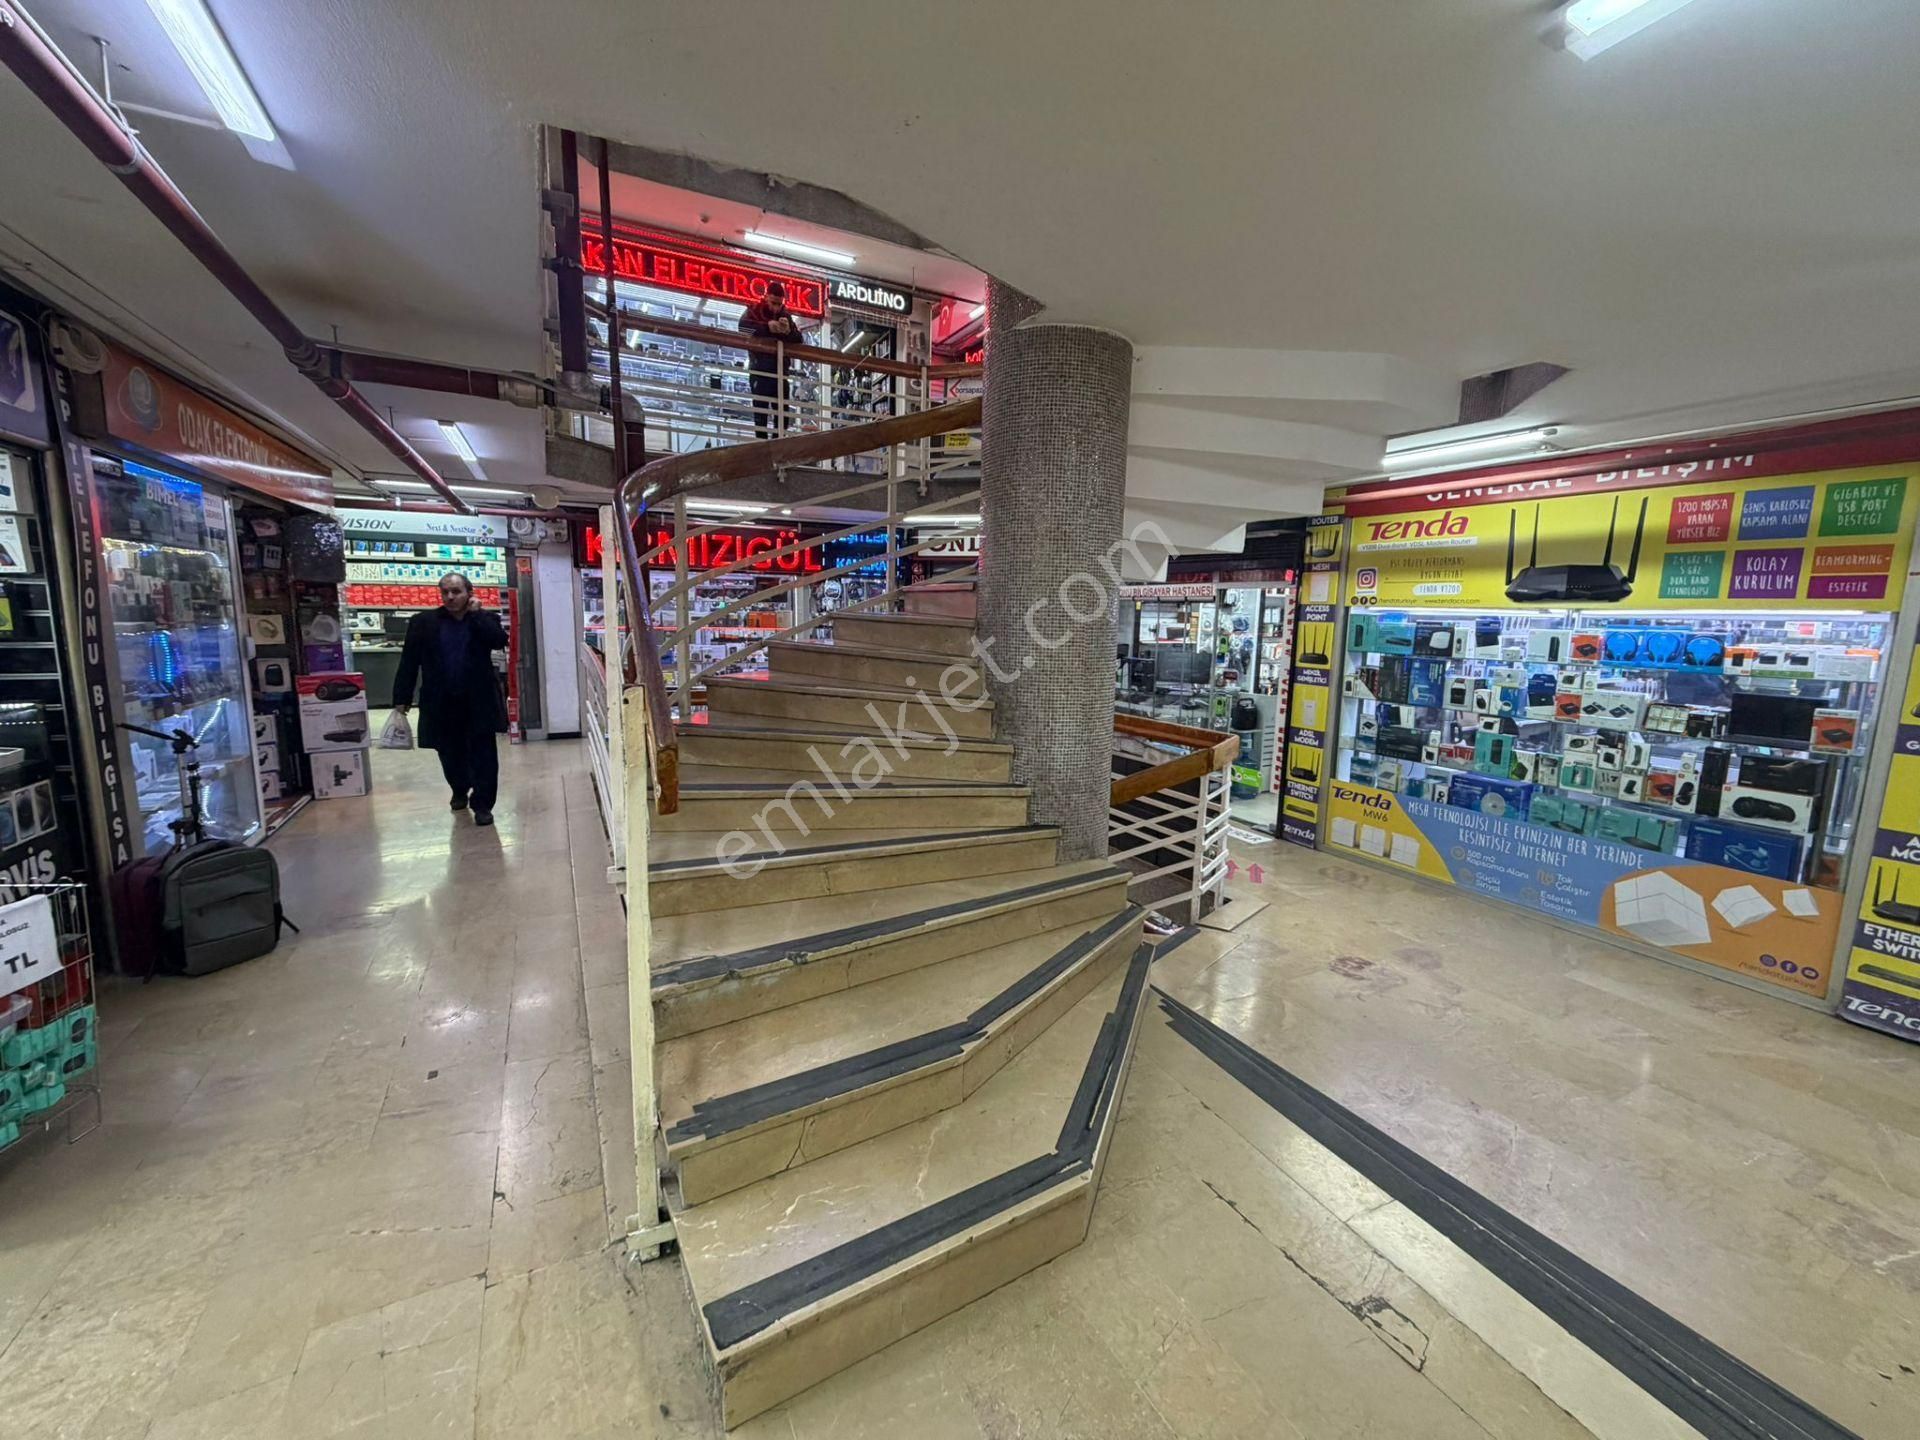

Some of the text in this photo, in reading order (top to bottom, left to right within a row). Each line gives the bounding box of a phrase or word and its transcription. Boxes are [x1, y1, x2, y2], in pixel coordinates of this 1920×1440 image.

[653, 254, 813, 310] ELEKTROİK
[1311, 515, 1339, 526] ROUTER
[1367, 510, 1470, 541] Tenda
[466, 535, 495, 545] EFOR
[67, 441, 99, 666] TELEFONU
[1746, 556, 1789, 571] KOLAY
[1734, 574, 1795, 591] KURULUM
[1305, 604, 1330, 613] ACCESS
[1306, 613, 1328, 621] POINT
[1294, 736, 1319, 746] MODEM
[1287, 781, 1319, 794] ETHERNET
[1290, 788, 1314, 801] SWITCH
[1332, 785, 1392, 811] Tenda
[1363, 808, 1388, 822] MW6
[1282, 822, 1316, 841] Tenda
[1408, 801, 1429, 817] MESH
[1567, 836, 1588, 856] HER
[4, 951, 39, 975] TL
